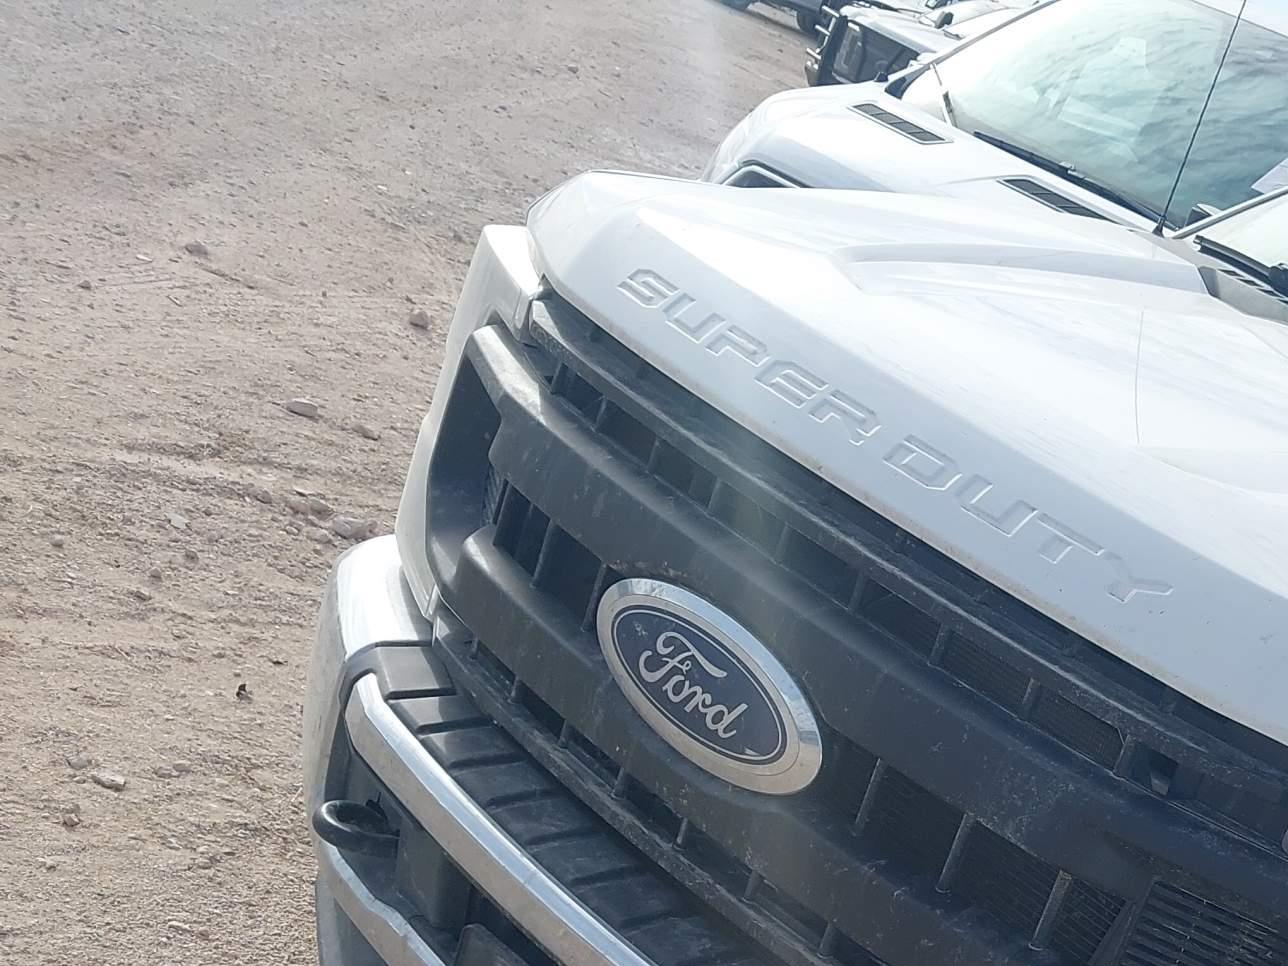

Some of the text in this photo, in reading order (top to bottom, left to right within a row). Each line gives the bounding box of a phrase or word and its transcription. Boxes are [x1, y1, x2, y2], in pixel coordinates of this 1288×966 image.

[617, 268, 1174, 602] SUPER DUTY
[638, 631, 749, 739] Ford
